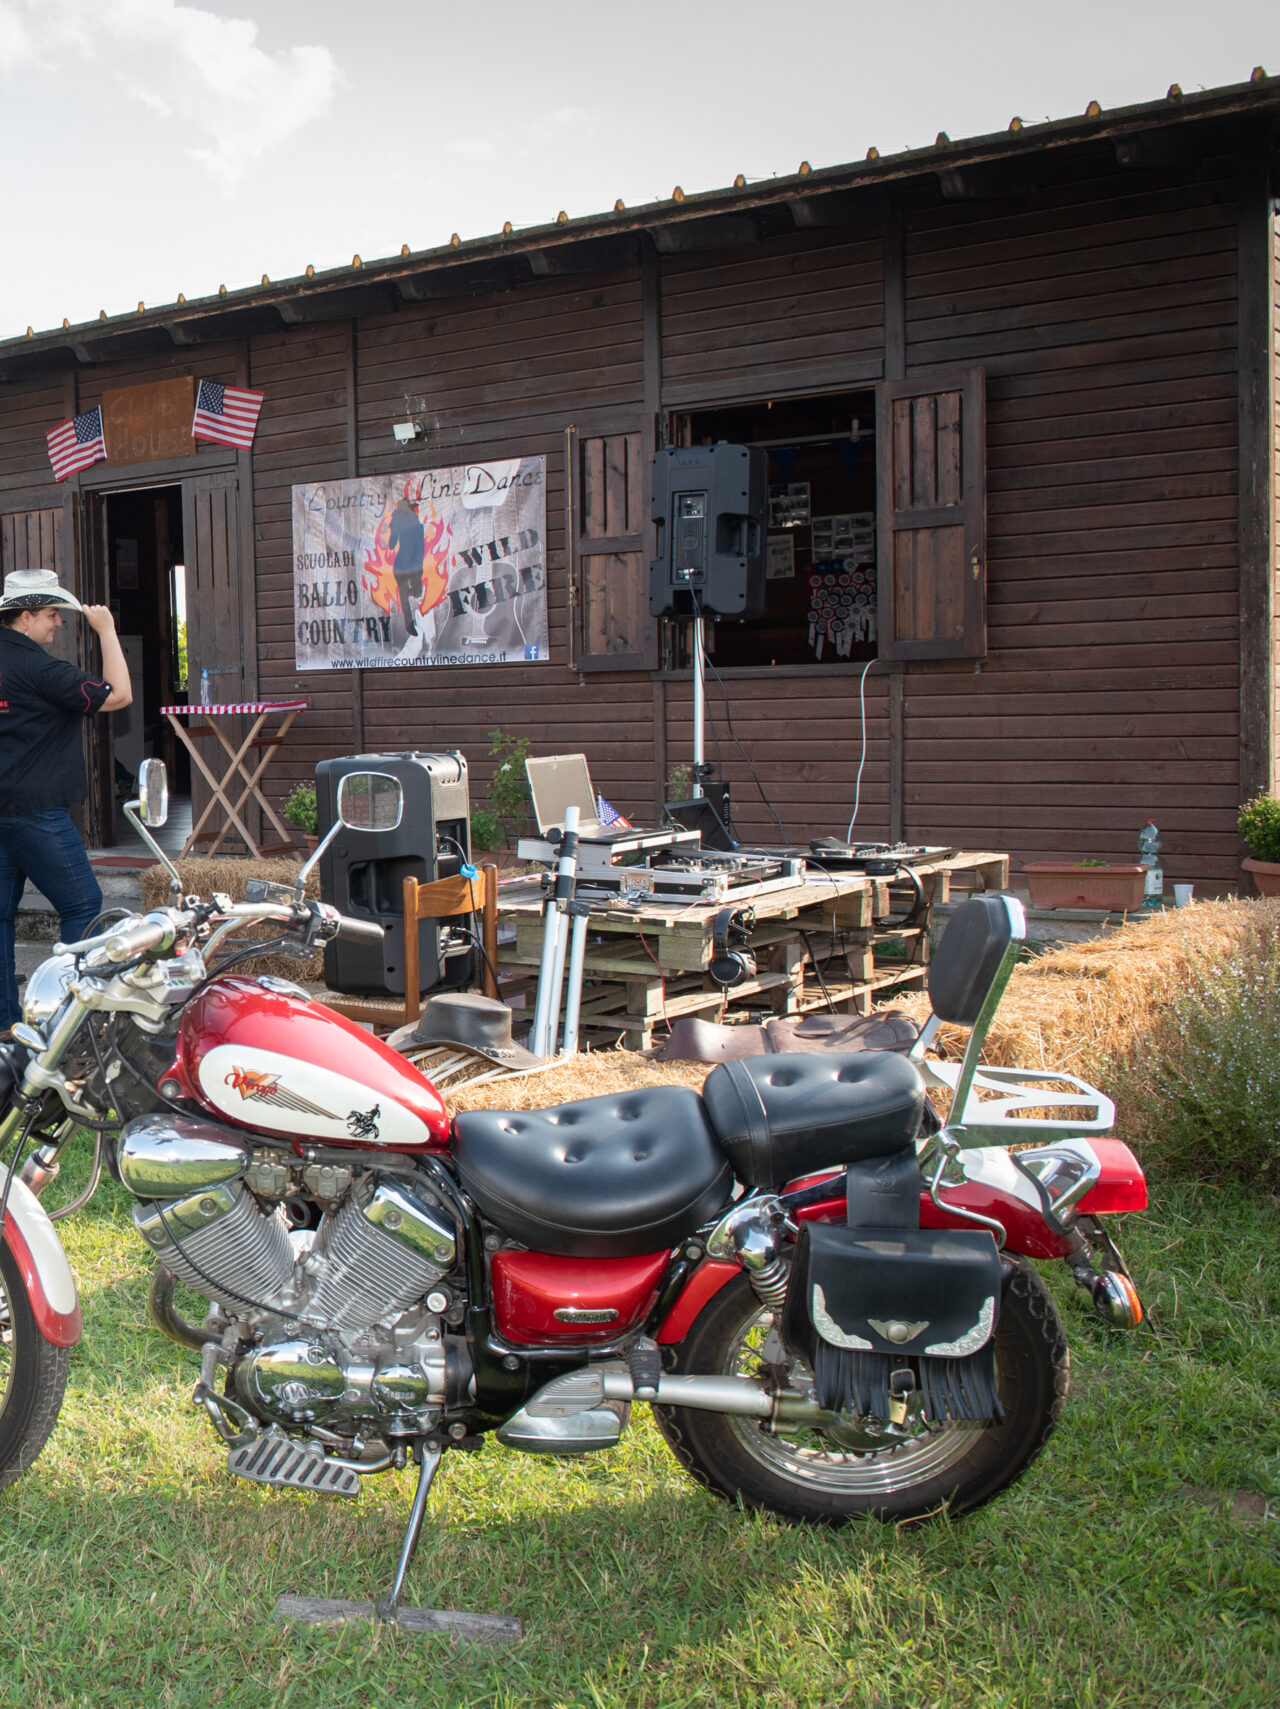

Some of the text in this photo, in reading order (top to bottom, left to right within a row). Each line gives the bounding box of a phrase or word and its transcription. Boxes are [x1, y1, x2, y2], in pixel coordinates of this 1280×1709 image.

[309, 466, 543, 518] Country Line Dance
[296, 550, 356, 571] SCUOLA DI
[457, 528, 539, 568] WILD
[297, 580, 357, 608] BALLO
[447, 564, 545, 617] FIRE
[297, 616, 391, 646] COUNTRY
[331, 650, 506, 668] www.wildfirecountrylinedance.it
[224, 1072, 277, 1098] Virago
